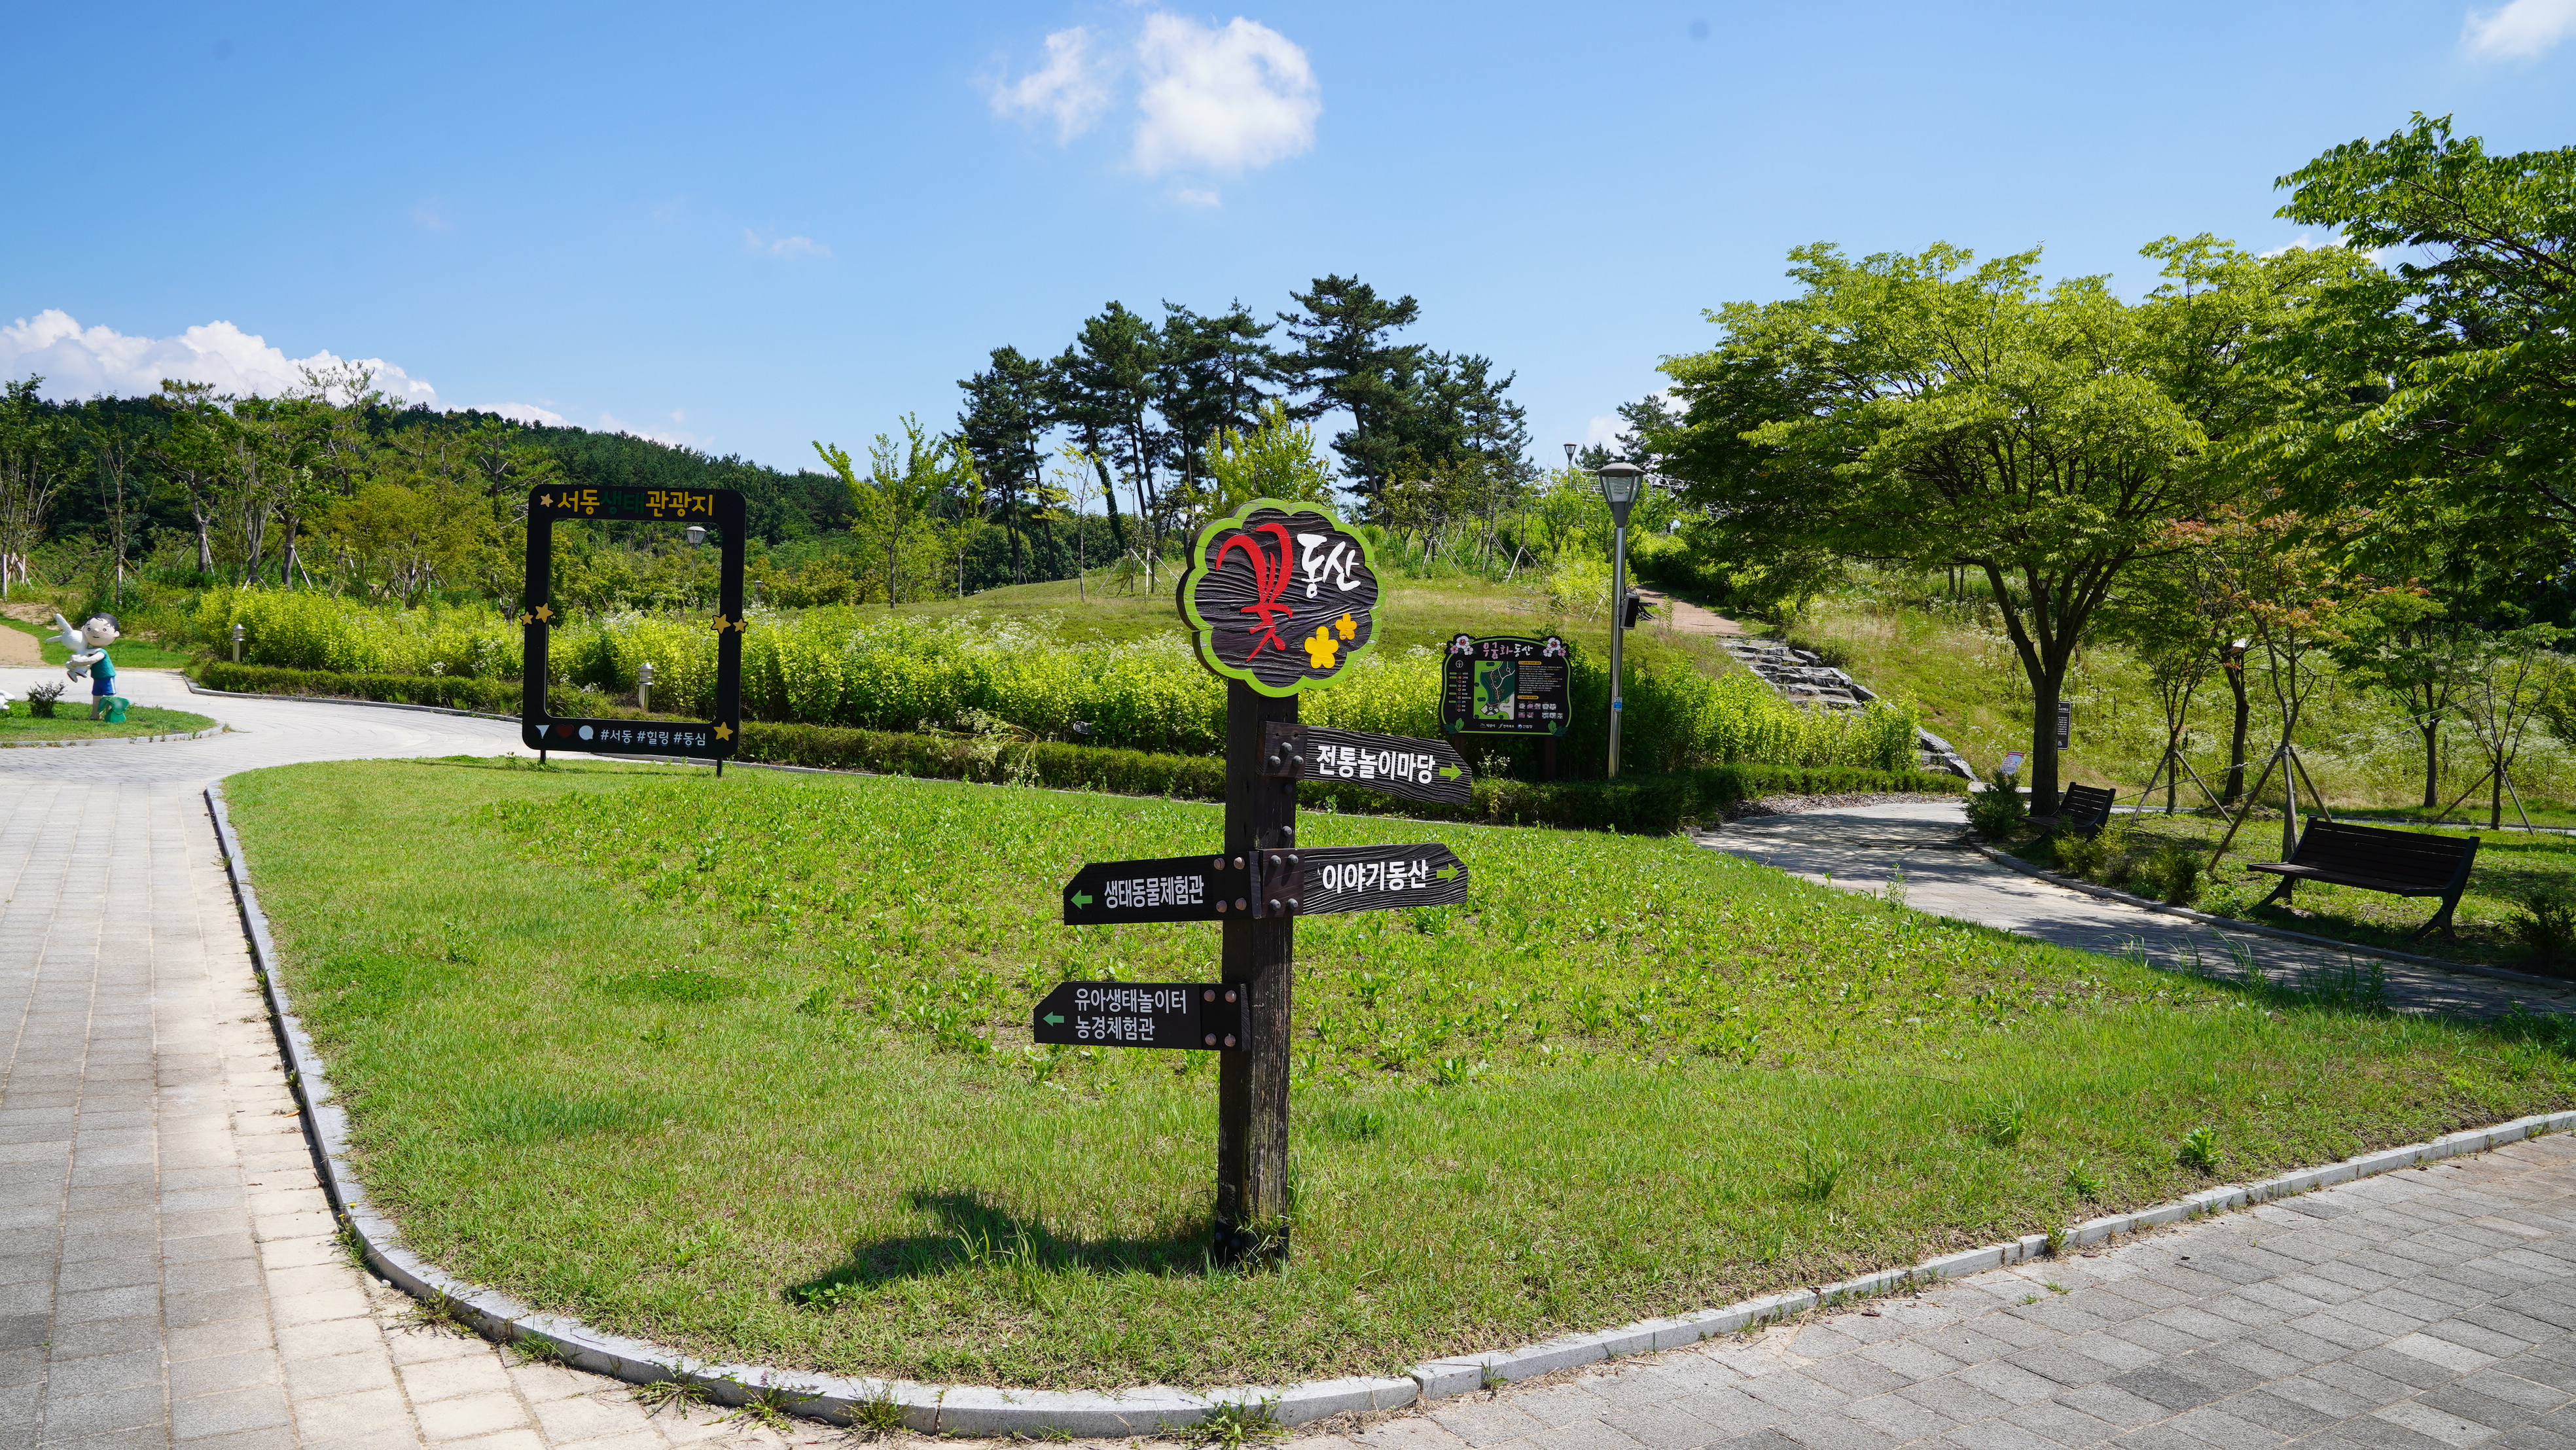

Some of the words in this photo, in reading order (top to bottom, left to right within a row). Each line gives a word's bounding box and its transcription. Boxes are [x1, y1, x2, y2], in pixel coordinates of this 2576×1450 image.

[601, 729, 633, 745] #서동
[637, 730, 669, 746] #힐링
[673, 732, 706, 746] #동심
[1316, 745, 1436, 785] 전통놀이마당
[1321, 860, 1430, 893] 이야기동산
[1104, 875, 1204, 909] 생태동물체험관
[1074, 988, 1187, 1014] 유아생태놀이터
[1075, 1016, 1155, 1041] 농경체험관
